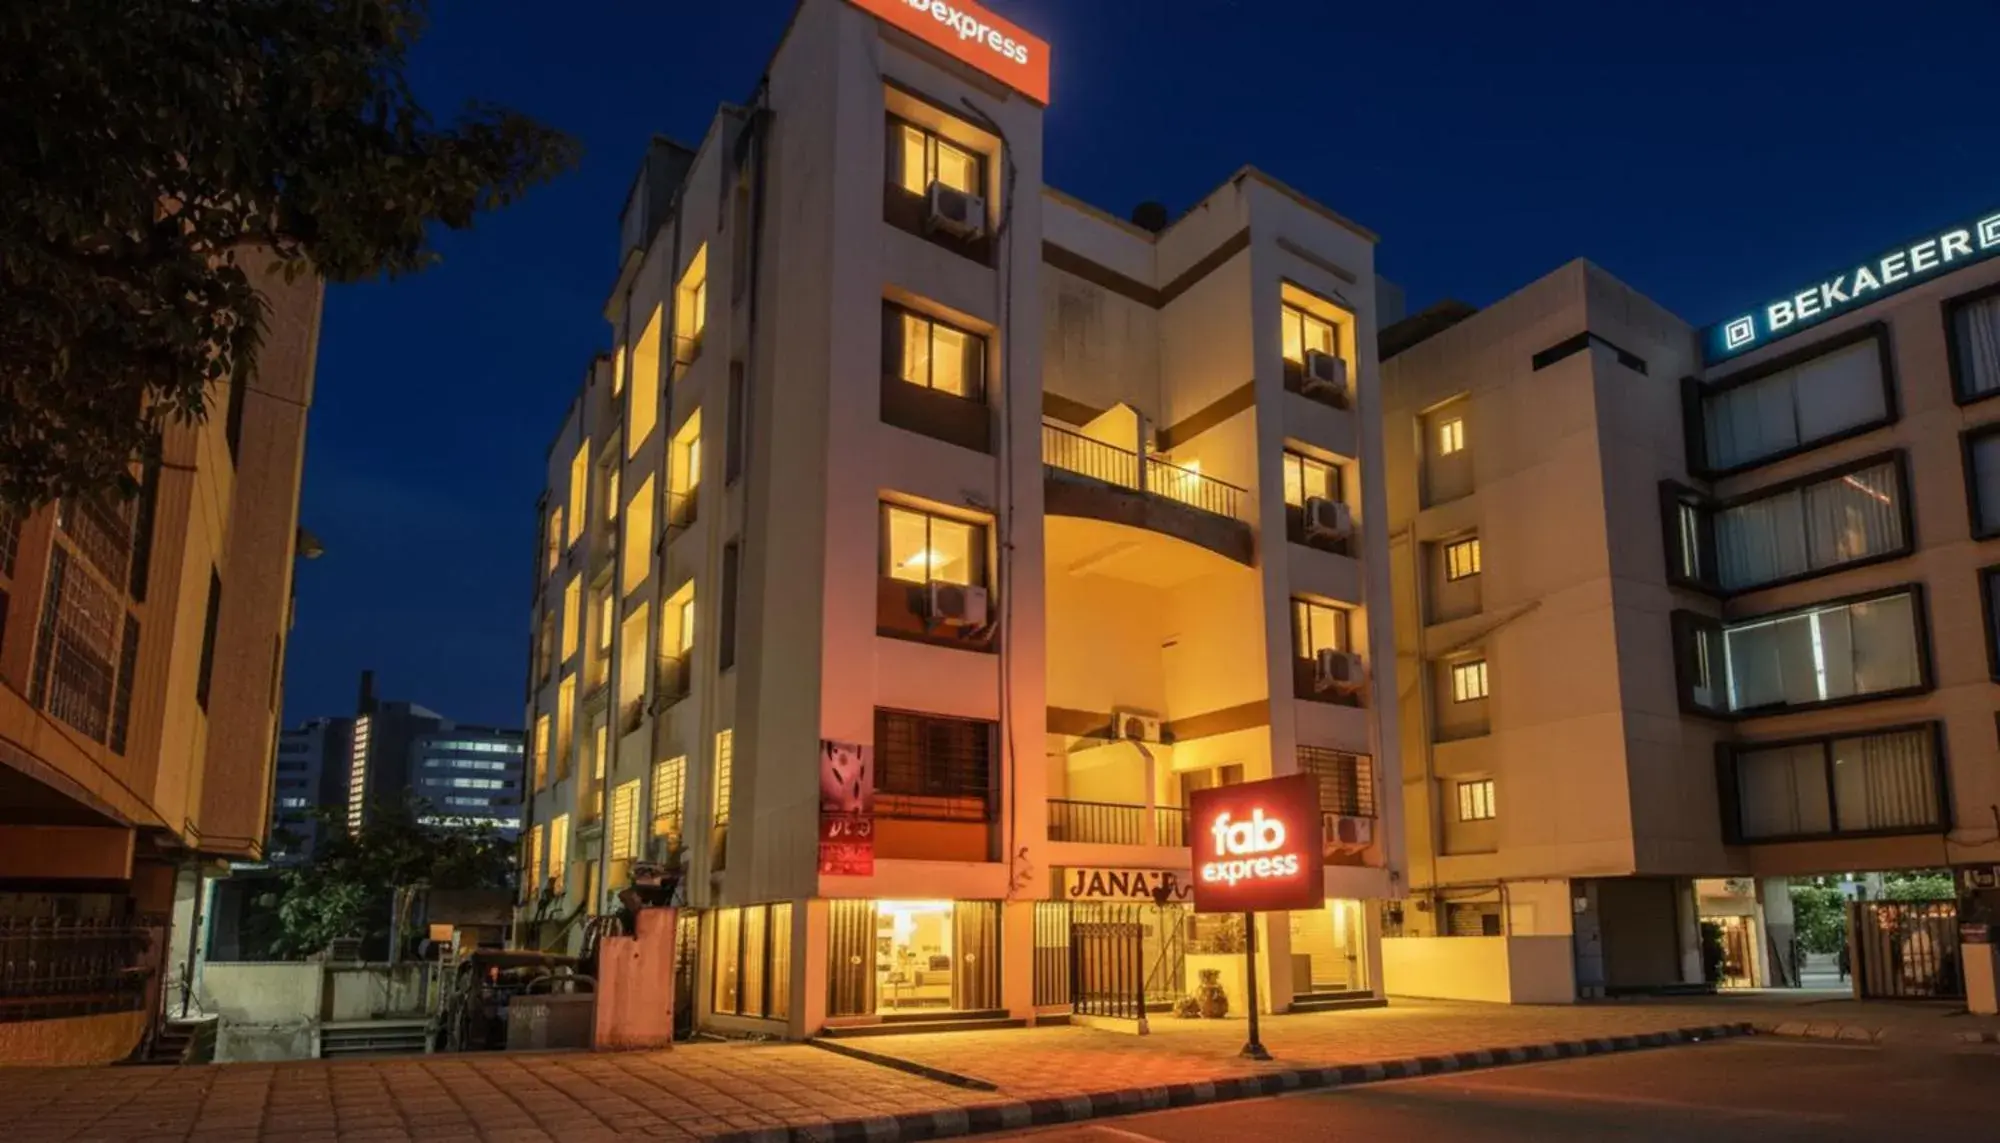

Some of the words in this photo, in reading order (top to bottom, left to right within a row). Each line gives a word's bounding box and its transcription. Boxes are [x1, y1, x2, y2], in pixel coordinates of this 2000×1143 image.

[1767, 229, 1973, 331] BEKAEER
[1212, 808, 1285, 855] fab
[1202, 853, 1298, 885] express
